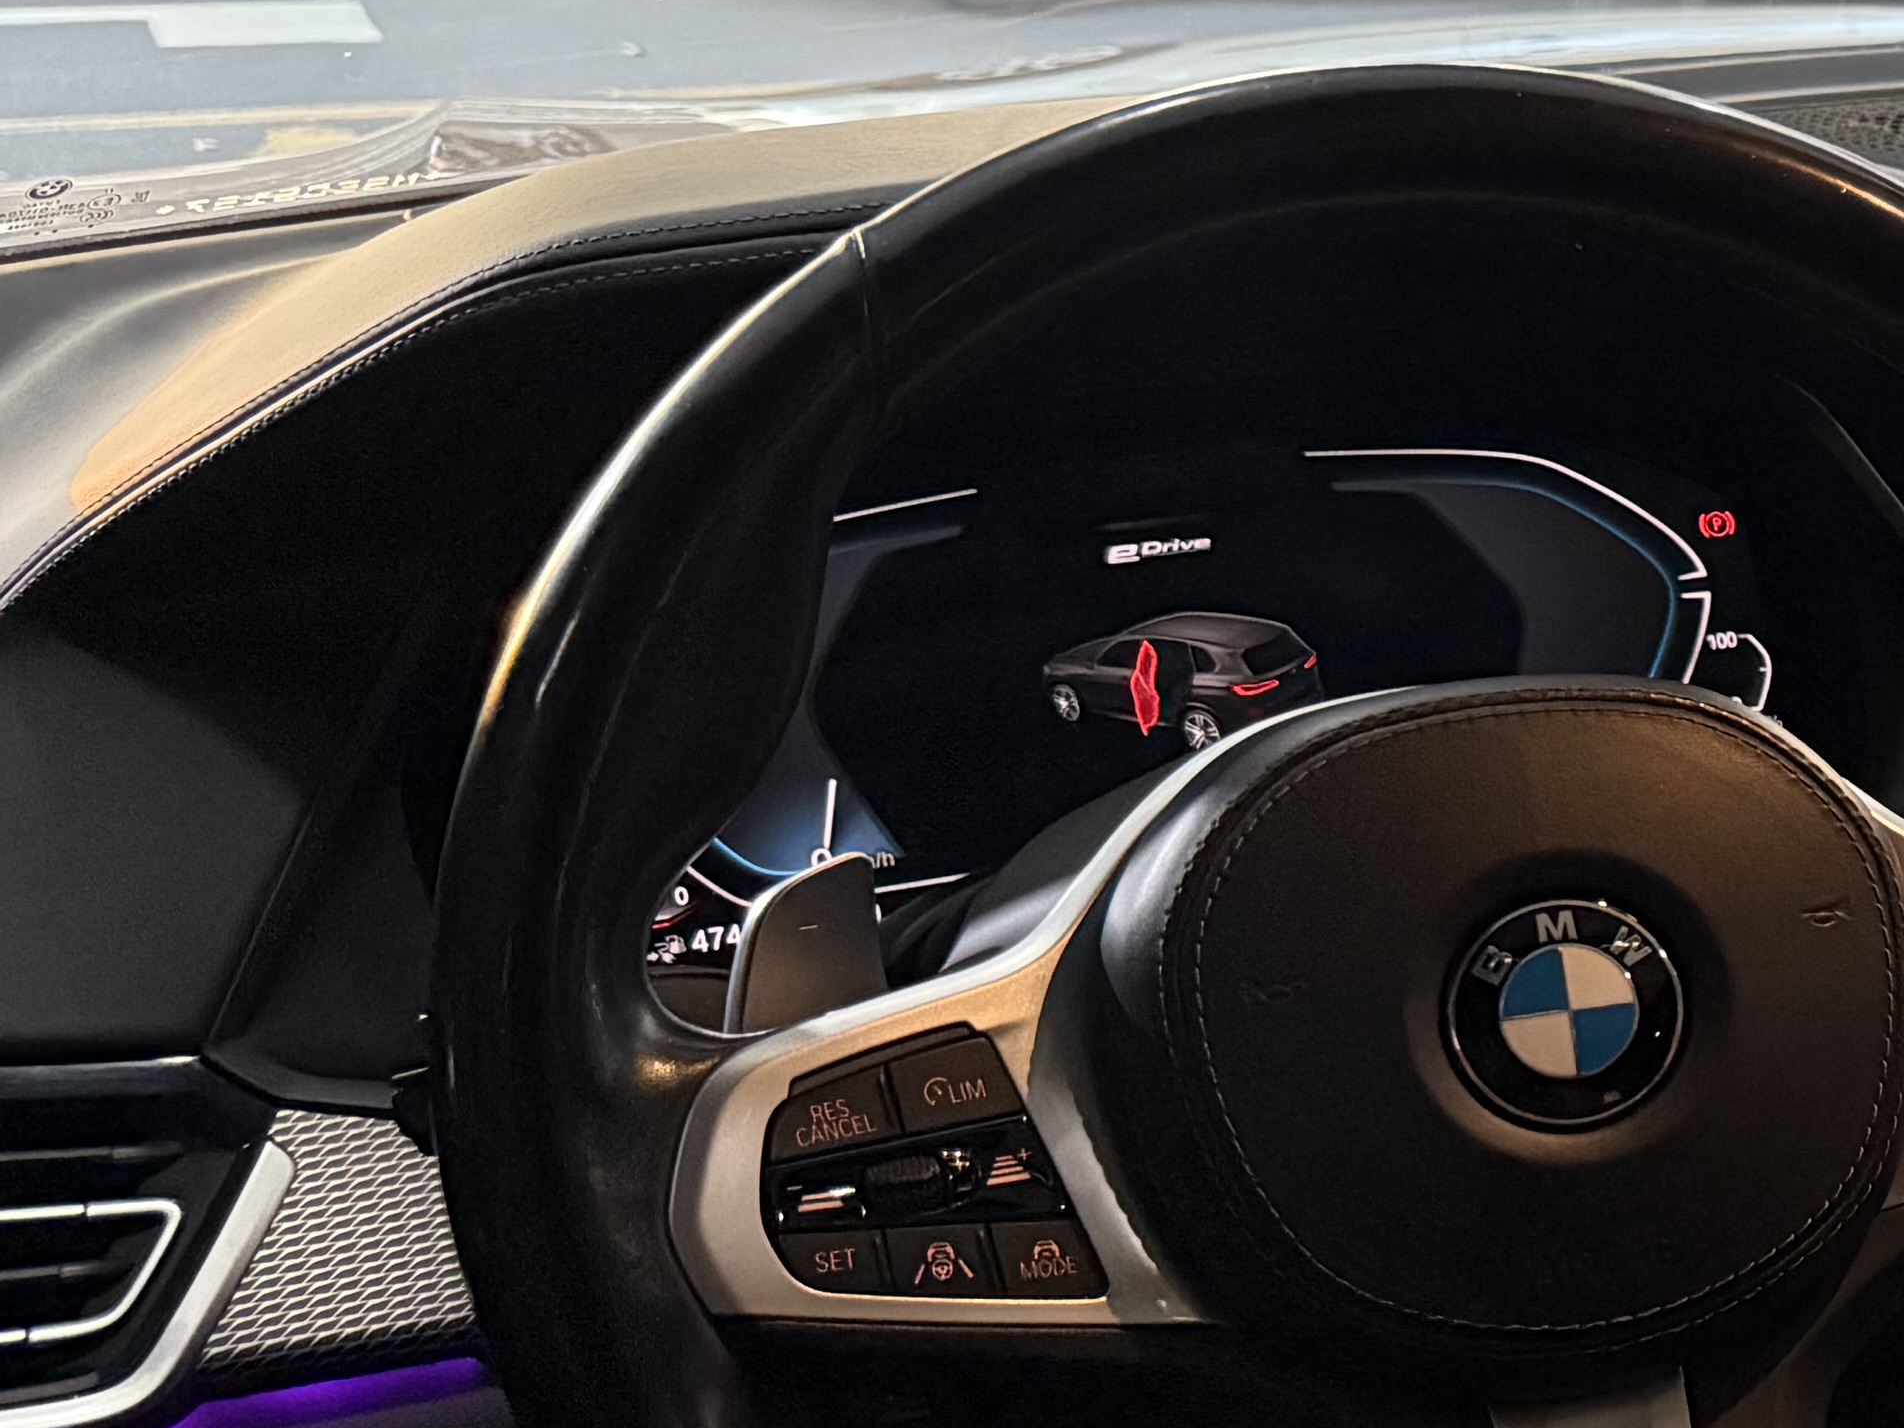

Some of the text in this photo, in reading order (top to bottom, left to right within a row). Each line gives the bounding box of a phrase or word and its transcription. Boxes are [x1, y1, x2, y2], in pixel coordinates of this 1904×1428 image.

[1706, 630, 1738, 651] 100
[673, 886, 690, 906] 0
[1471, 909, 1653, 986] BMW
[948, 1078, 988, 1106] LIM
[809, 1099, 850, 1123] RES
[795, 1113, 877, 1148] CANCEL
[815, 1248, 856, 1273] SET
[1019, 1256, 1079, 1281] MODE
